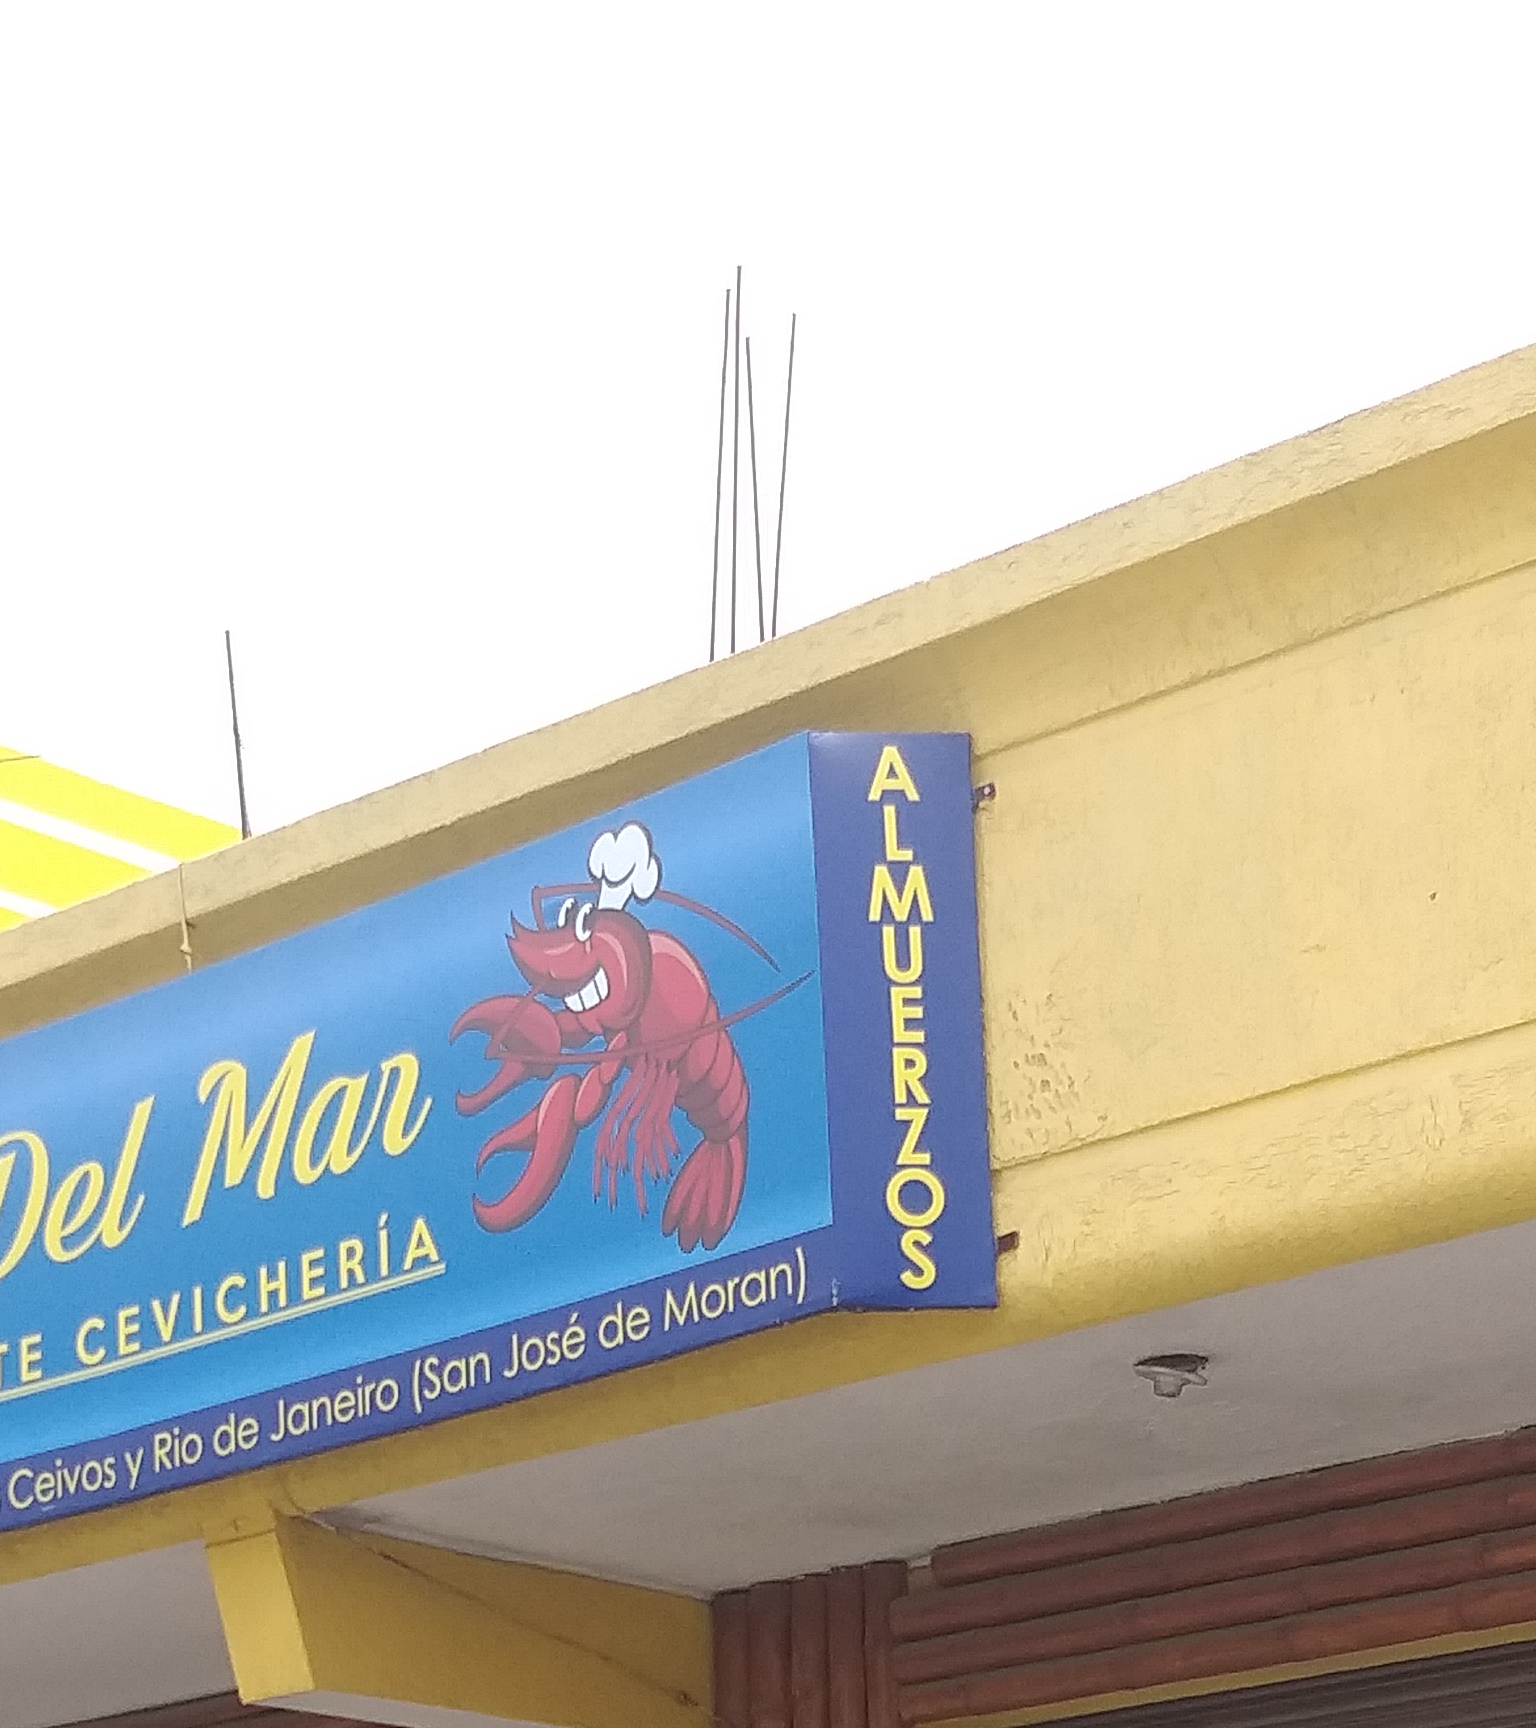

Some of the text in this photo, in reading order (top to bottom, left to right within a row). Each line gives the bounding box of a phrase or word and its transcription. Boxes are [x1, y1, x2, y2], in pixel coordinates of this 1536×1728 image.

[182, 1030, 433, 1226] Mar
[867, 745, 945, 1289] ALMUERZOS
[9, 1455, 117, 1508] Ceivos
[126, 1446, 145, 1490] y
[153, 1425, 203, 1472] Rio
[213, 1411, 260, 1453] de
[270, 1374, 401, 1444] Janeiro
[413, 1350, 491, 1414] (San
[503, 1311, 586, 1380] José
[599, 1301, 650, 1348] de
[662, 1247, 807, 1332] Moran)
[76, 1213, 443, 1367] CEVICHERÍA
